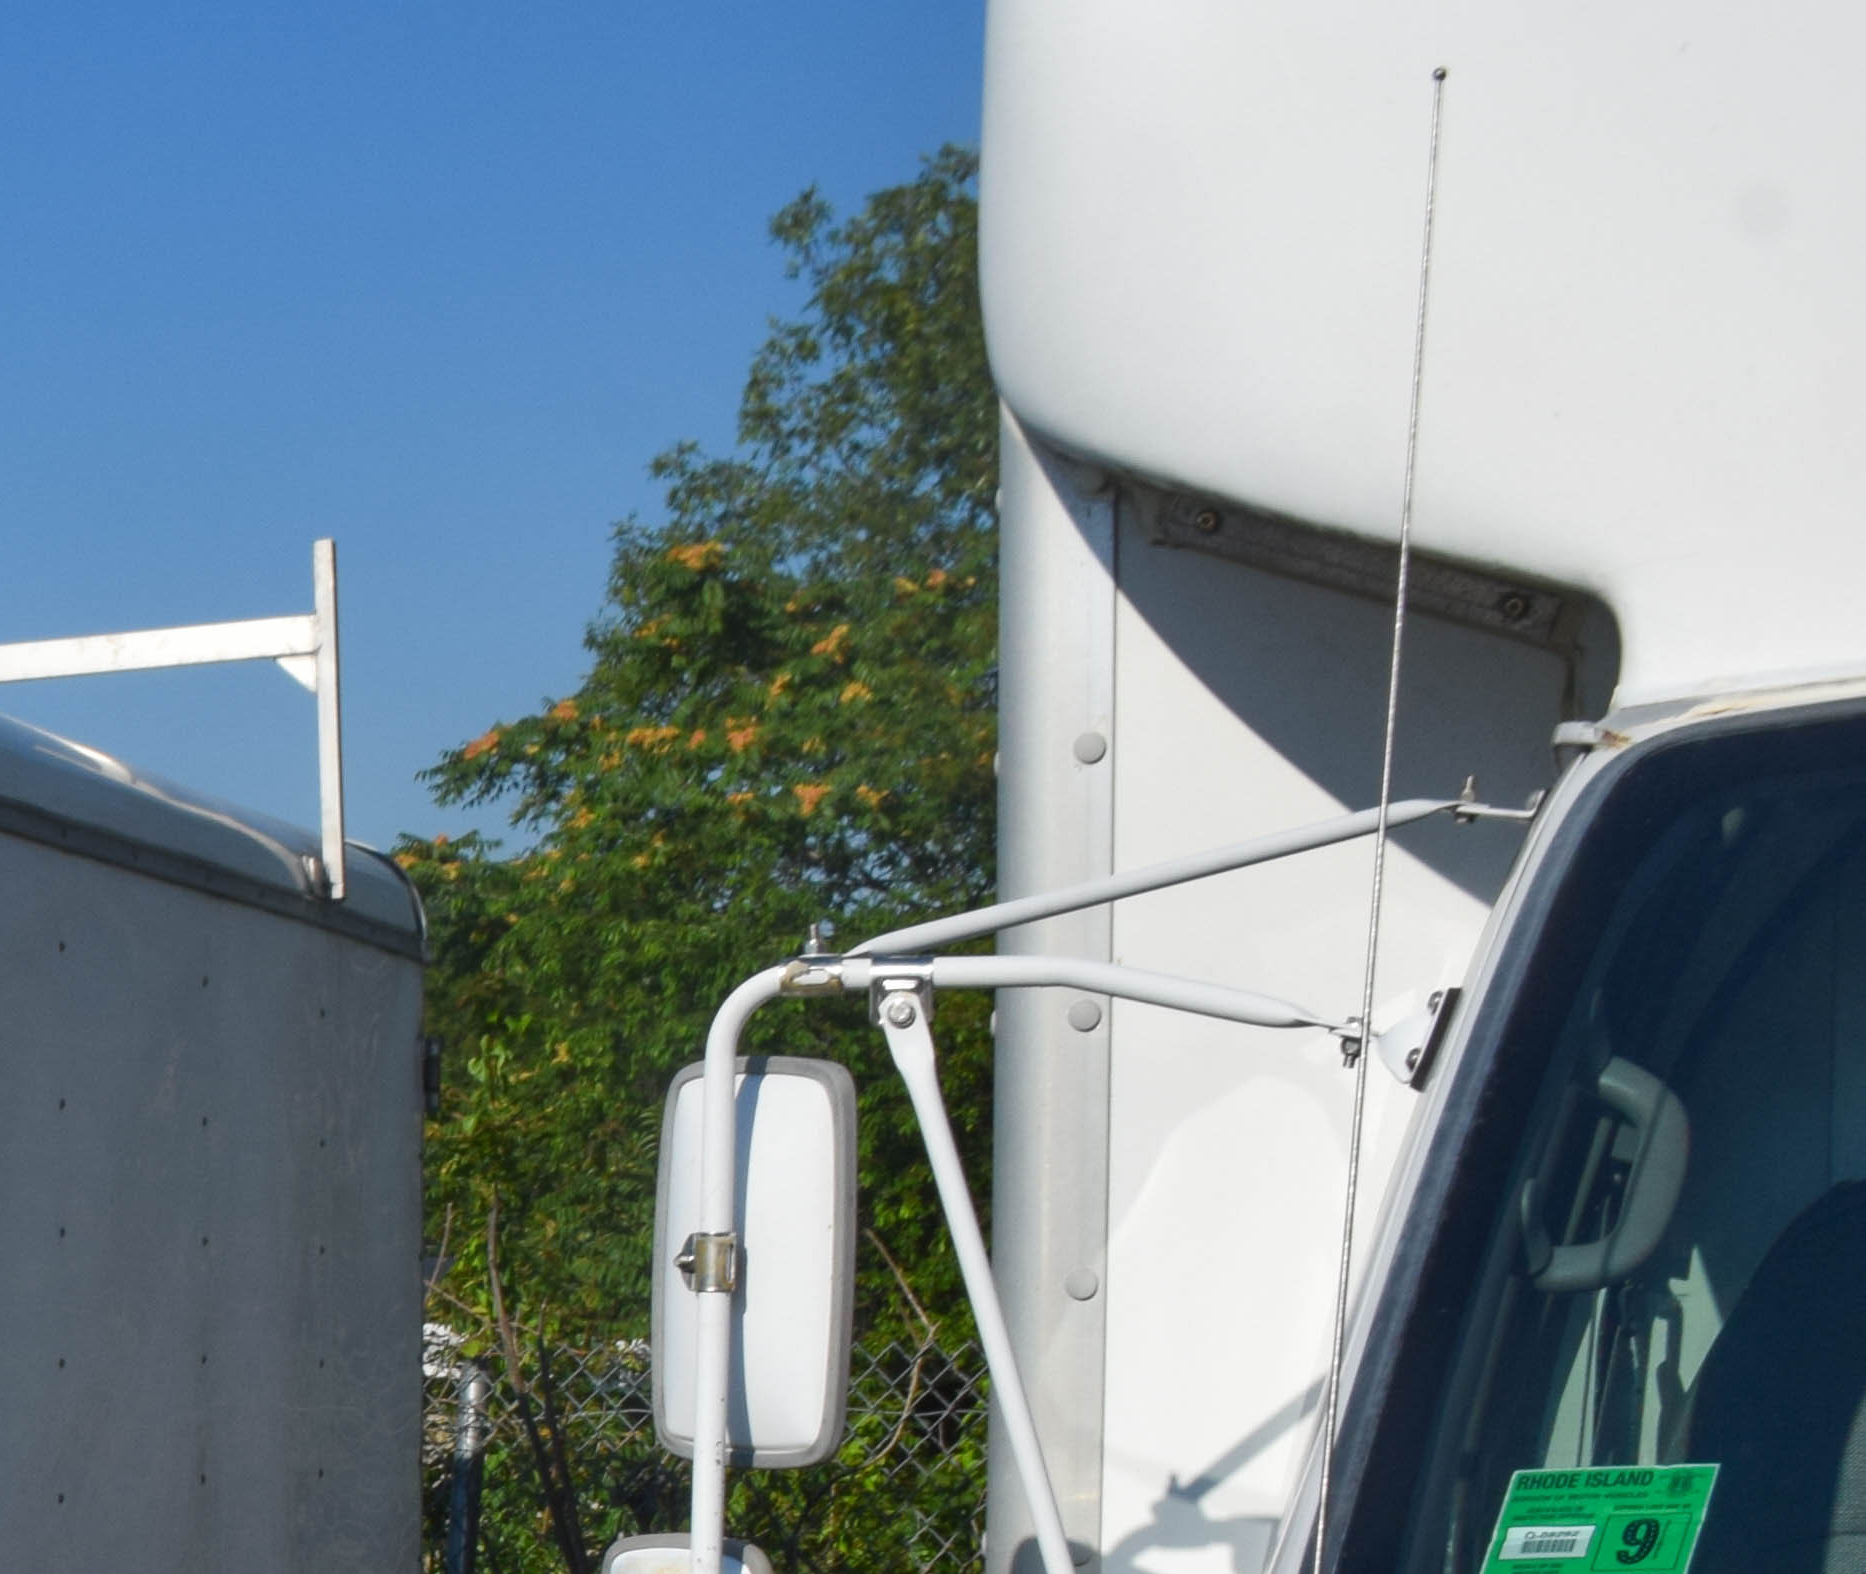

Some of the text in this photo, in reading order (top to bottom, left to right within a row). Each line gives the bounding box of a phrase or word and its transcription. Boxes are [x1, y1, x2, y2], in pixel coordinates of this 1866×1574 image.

[1516, 1471, 1655, 1490] RHODE ISLAND
[1616, 1517, 1661, 1566] 9
